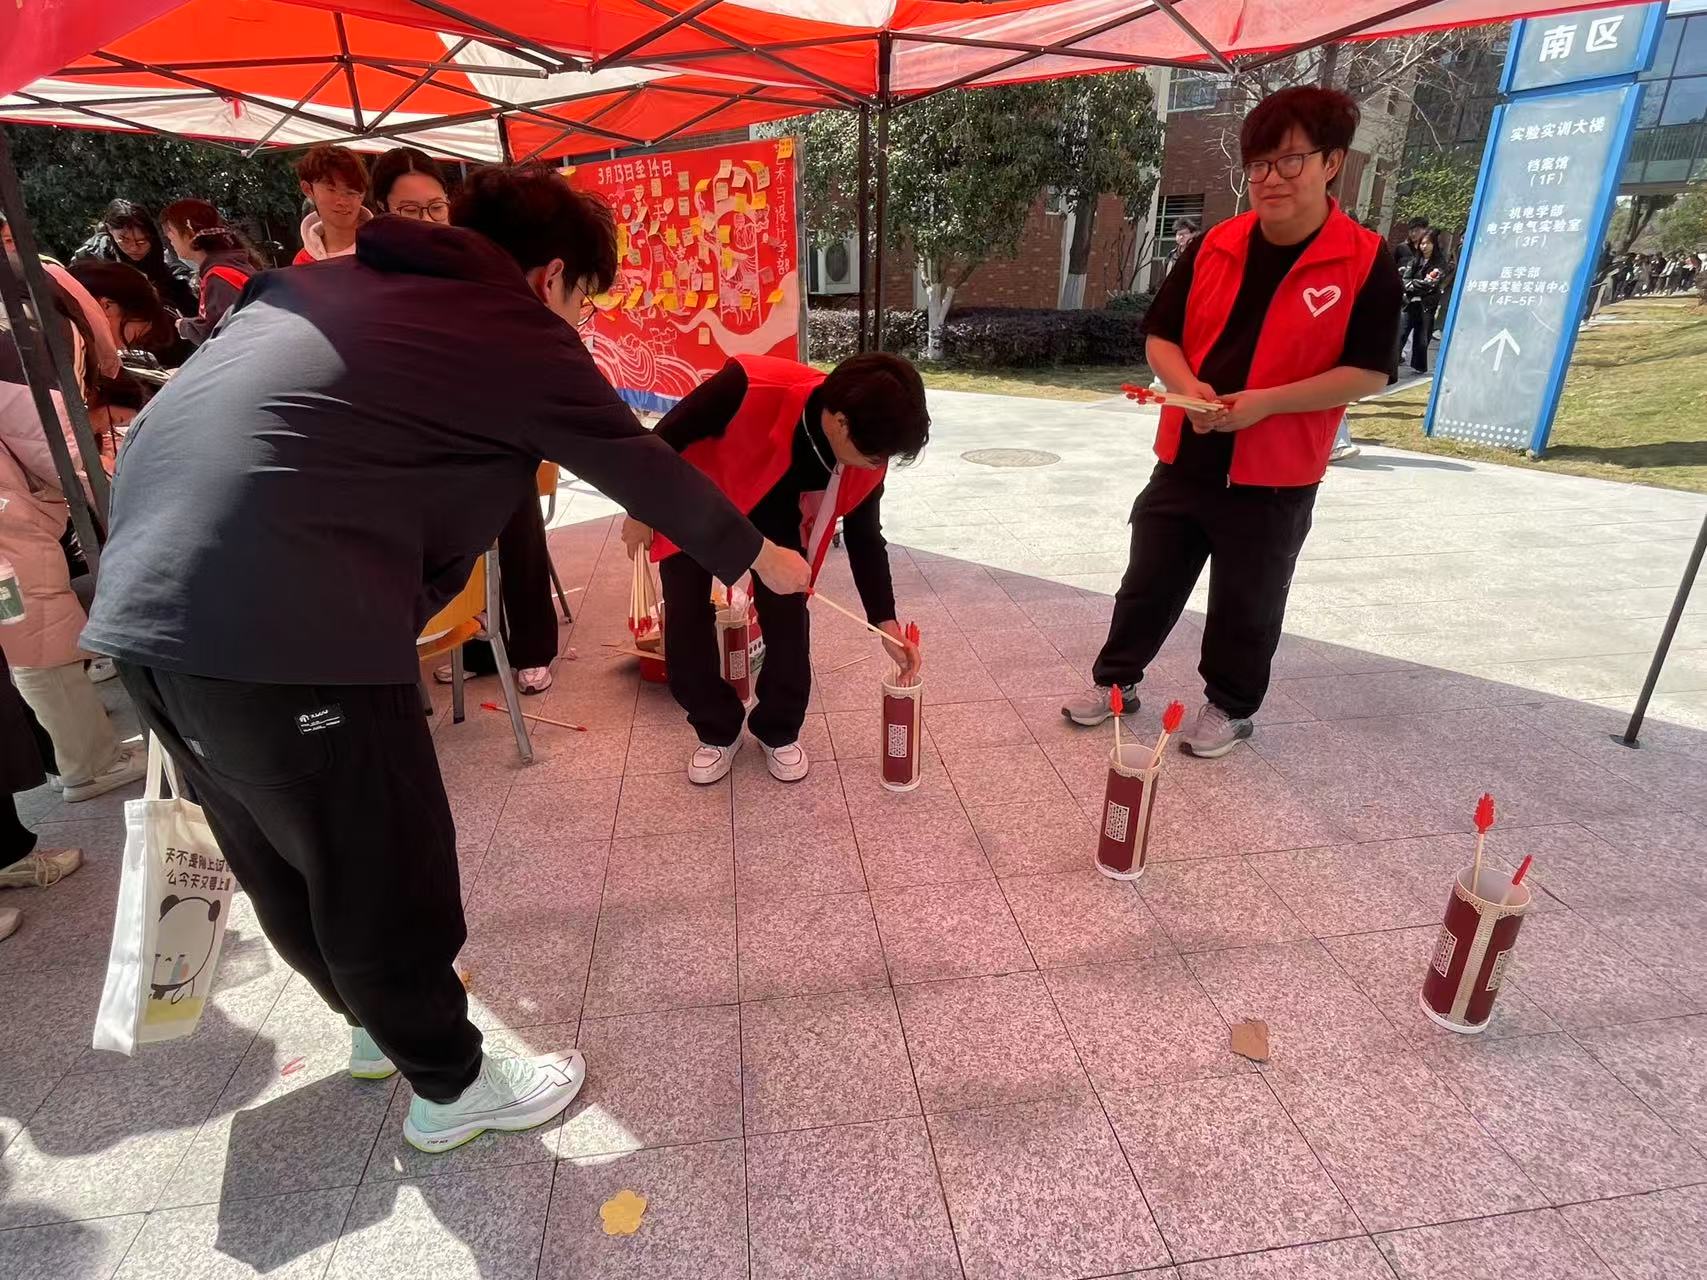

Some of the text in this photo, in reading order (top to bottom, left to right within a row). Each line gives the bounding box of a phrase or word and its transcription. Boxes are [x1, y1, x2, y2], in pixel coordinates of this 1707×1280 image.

[1539, 15, 1625, 62] 南区
[1509, 116, 1606, 142] 实验实训大楼
[597, 157, 673, 185] 3月13日至14日
[1527, 155, 1569, 173] 档案馆
[1508, 204, 1565, 219] 机电学部
[1486, 218, 1583, 235] 电子电气实验室
[1500, 266, 1541, 279] 医学部
